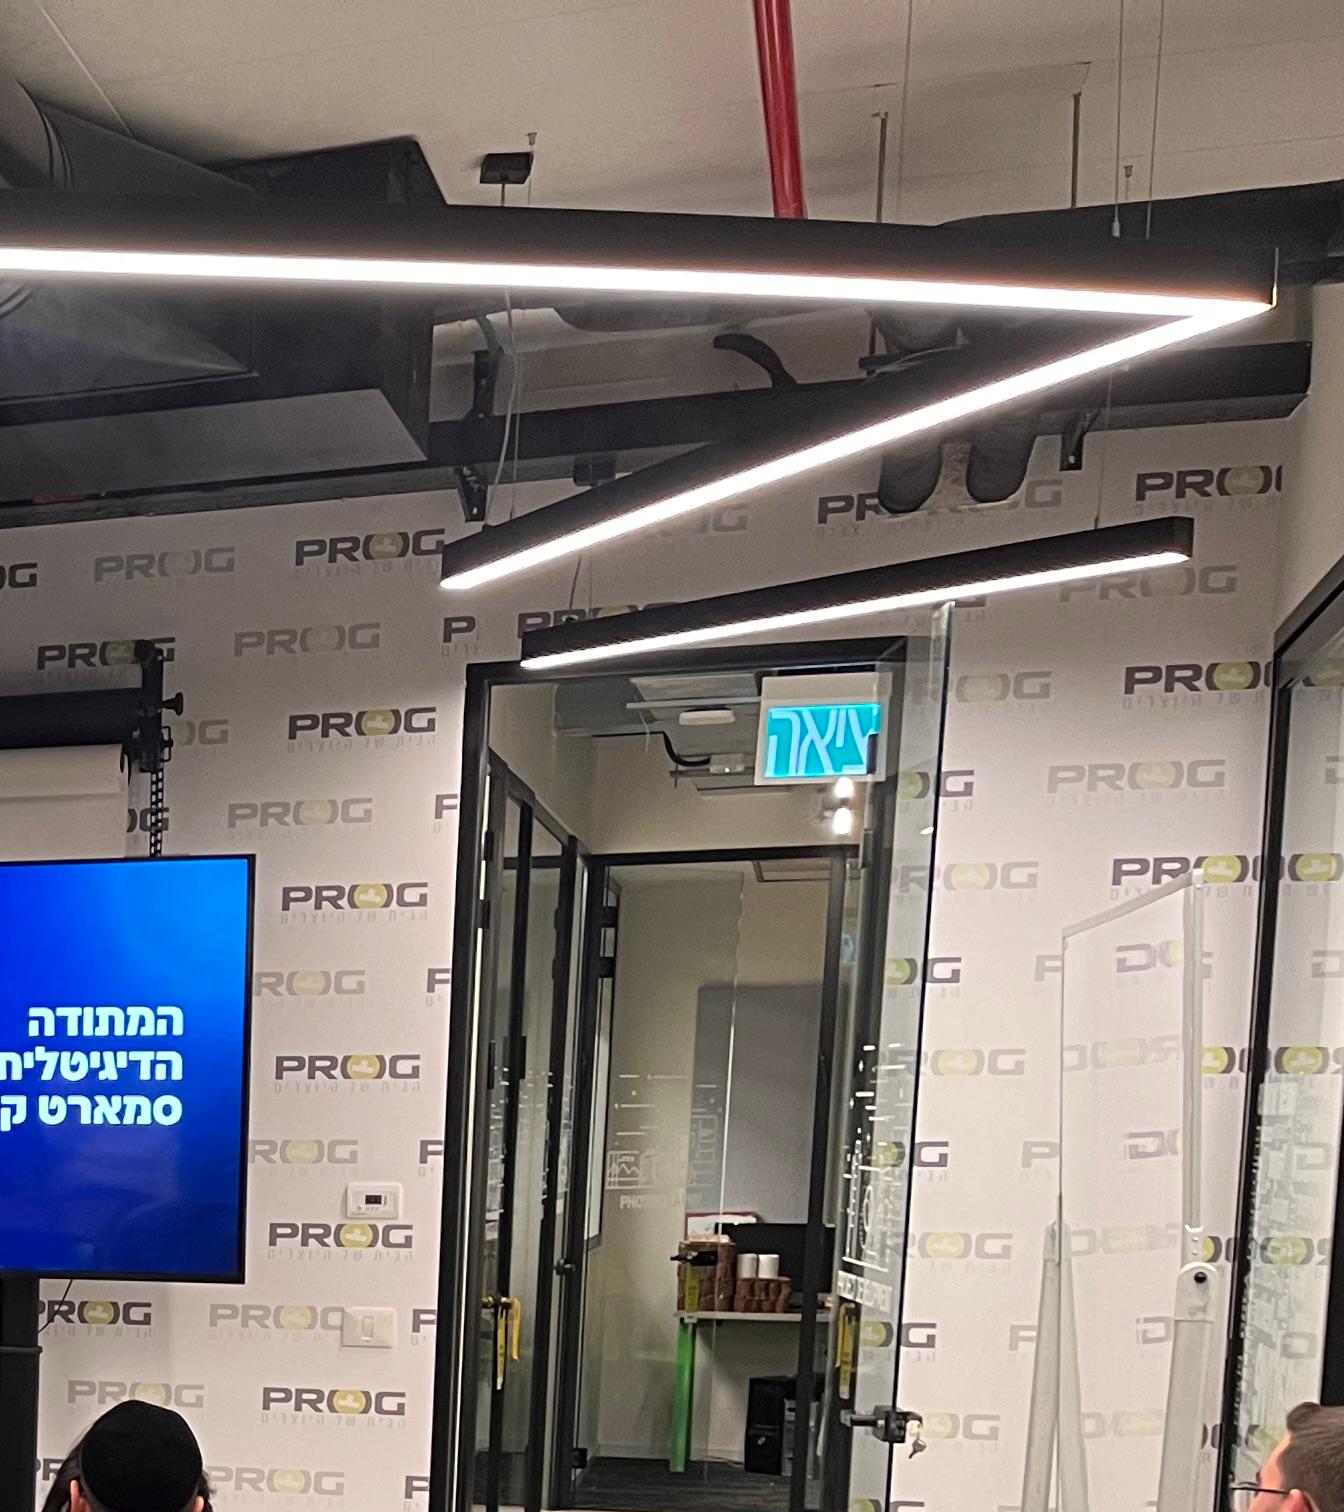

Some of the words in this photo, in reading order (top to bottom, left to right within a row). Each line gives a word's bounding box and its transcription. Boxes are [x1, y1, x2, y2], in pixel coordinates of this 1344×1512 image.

[1136, 465, 1282, 501] PRO
[295, 529, 445, 566] PROG
[1124, 660, 1274, 695] PRO
[288, 707, 436, 740] PROG
[1111, 855, 1263, 886] PRO
[281, 882, 428, 911] PROG
[254, 970, 365, 997] ROG
[28, 1006, 184, 1037] המתודה
[275, 1055, 420, 1080] PROG
[38, 1095, 183, 1126] סמארט
[249, 1139, 358, 1164] ROG
[269, 1222, 413, 1248] PROG
[262, 1387, 406, 1416] PROG
